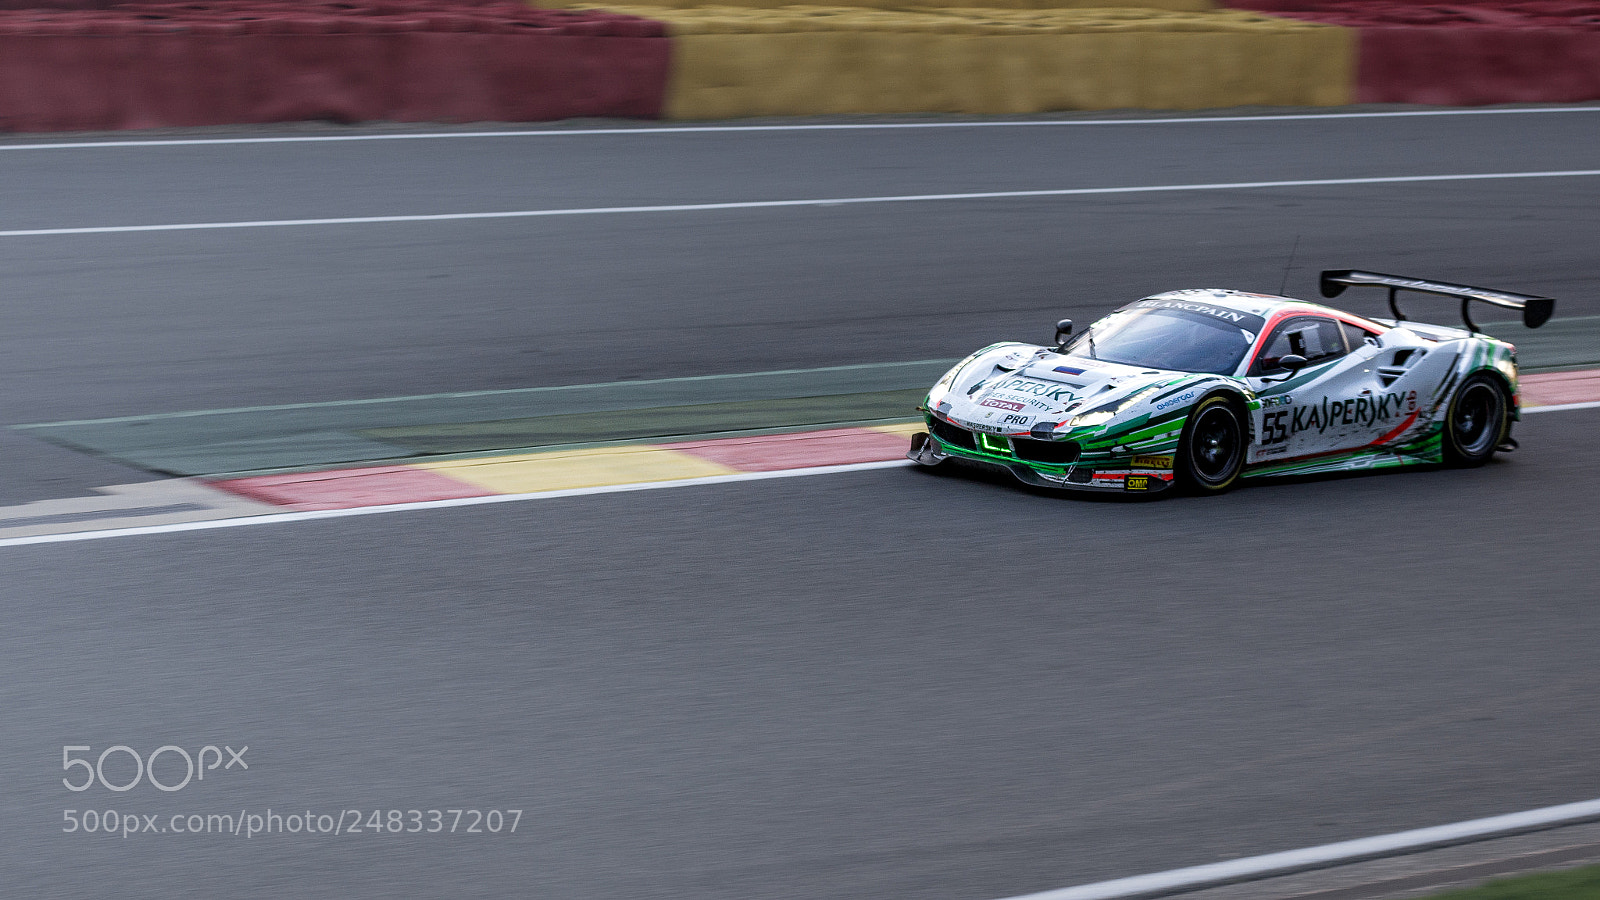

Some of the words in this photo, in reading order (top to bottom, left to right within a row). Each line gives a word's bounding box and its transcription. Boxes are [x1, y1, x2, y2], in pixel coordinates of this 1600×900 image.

[1136, 300, 1246, 322] BLANCPAIN
[983, 399, 1020, 411] TOTAL
[1005, 394, 1053, 412] SECURITY
[1291, 391, 1406, 434] KASPERSKY
[1003, 414, 1029, 425] PRO
[1262, 411, 1288, 445] 55
